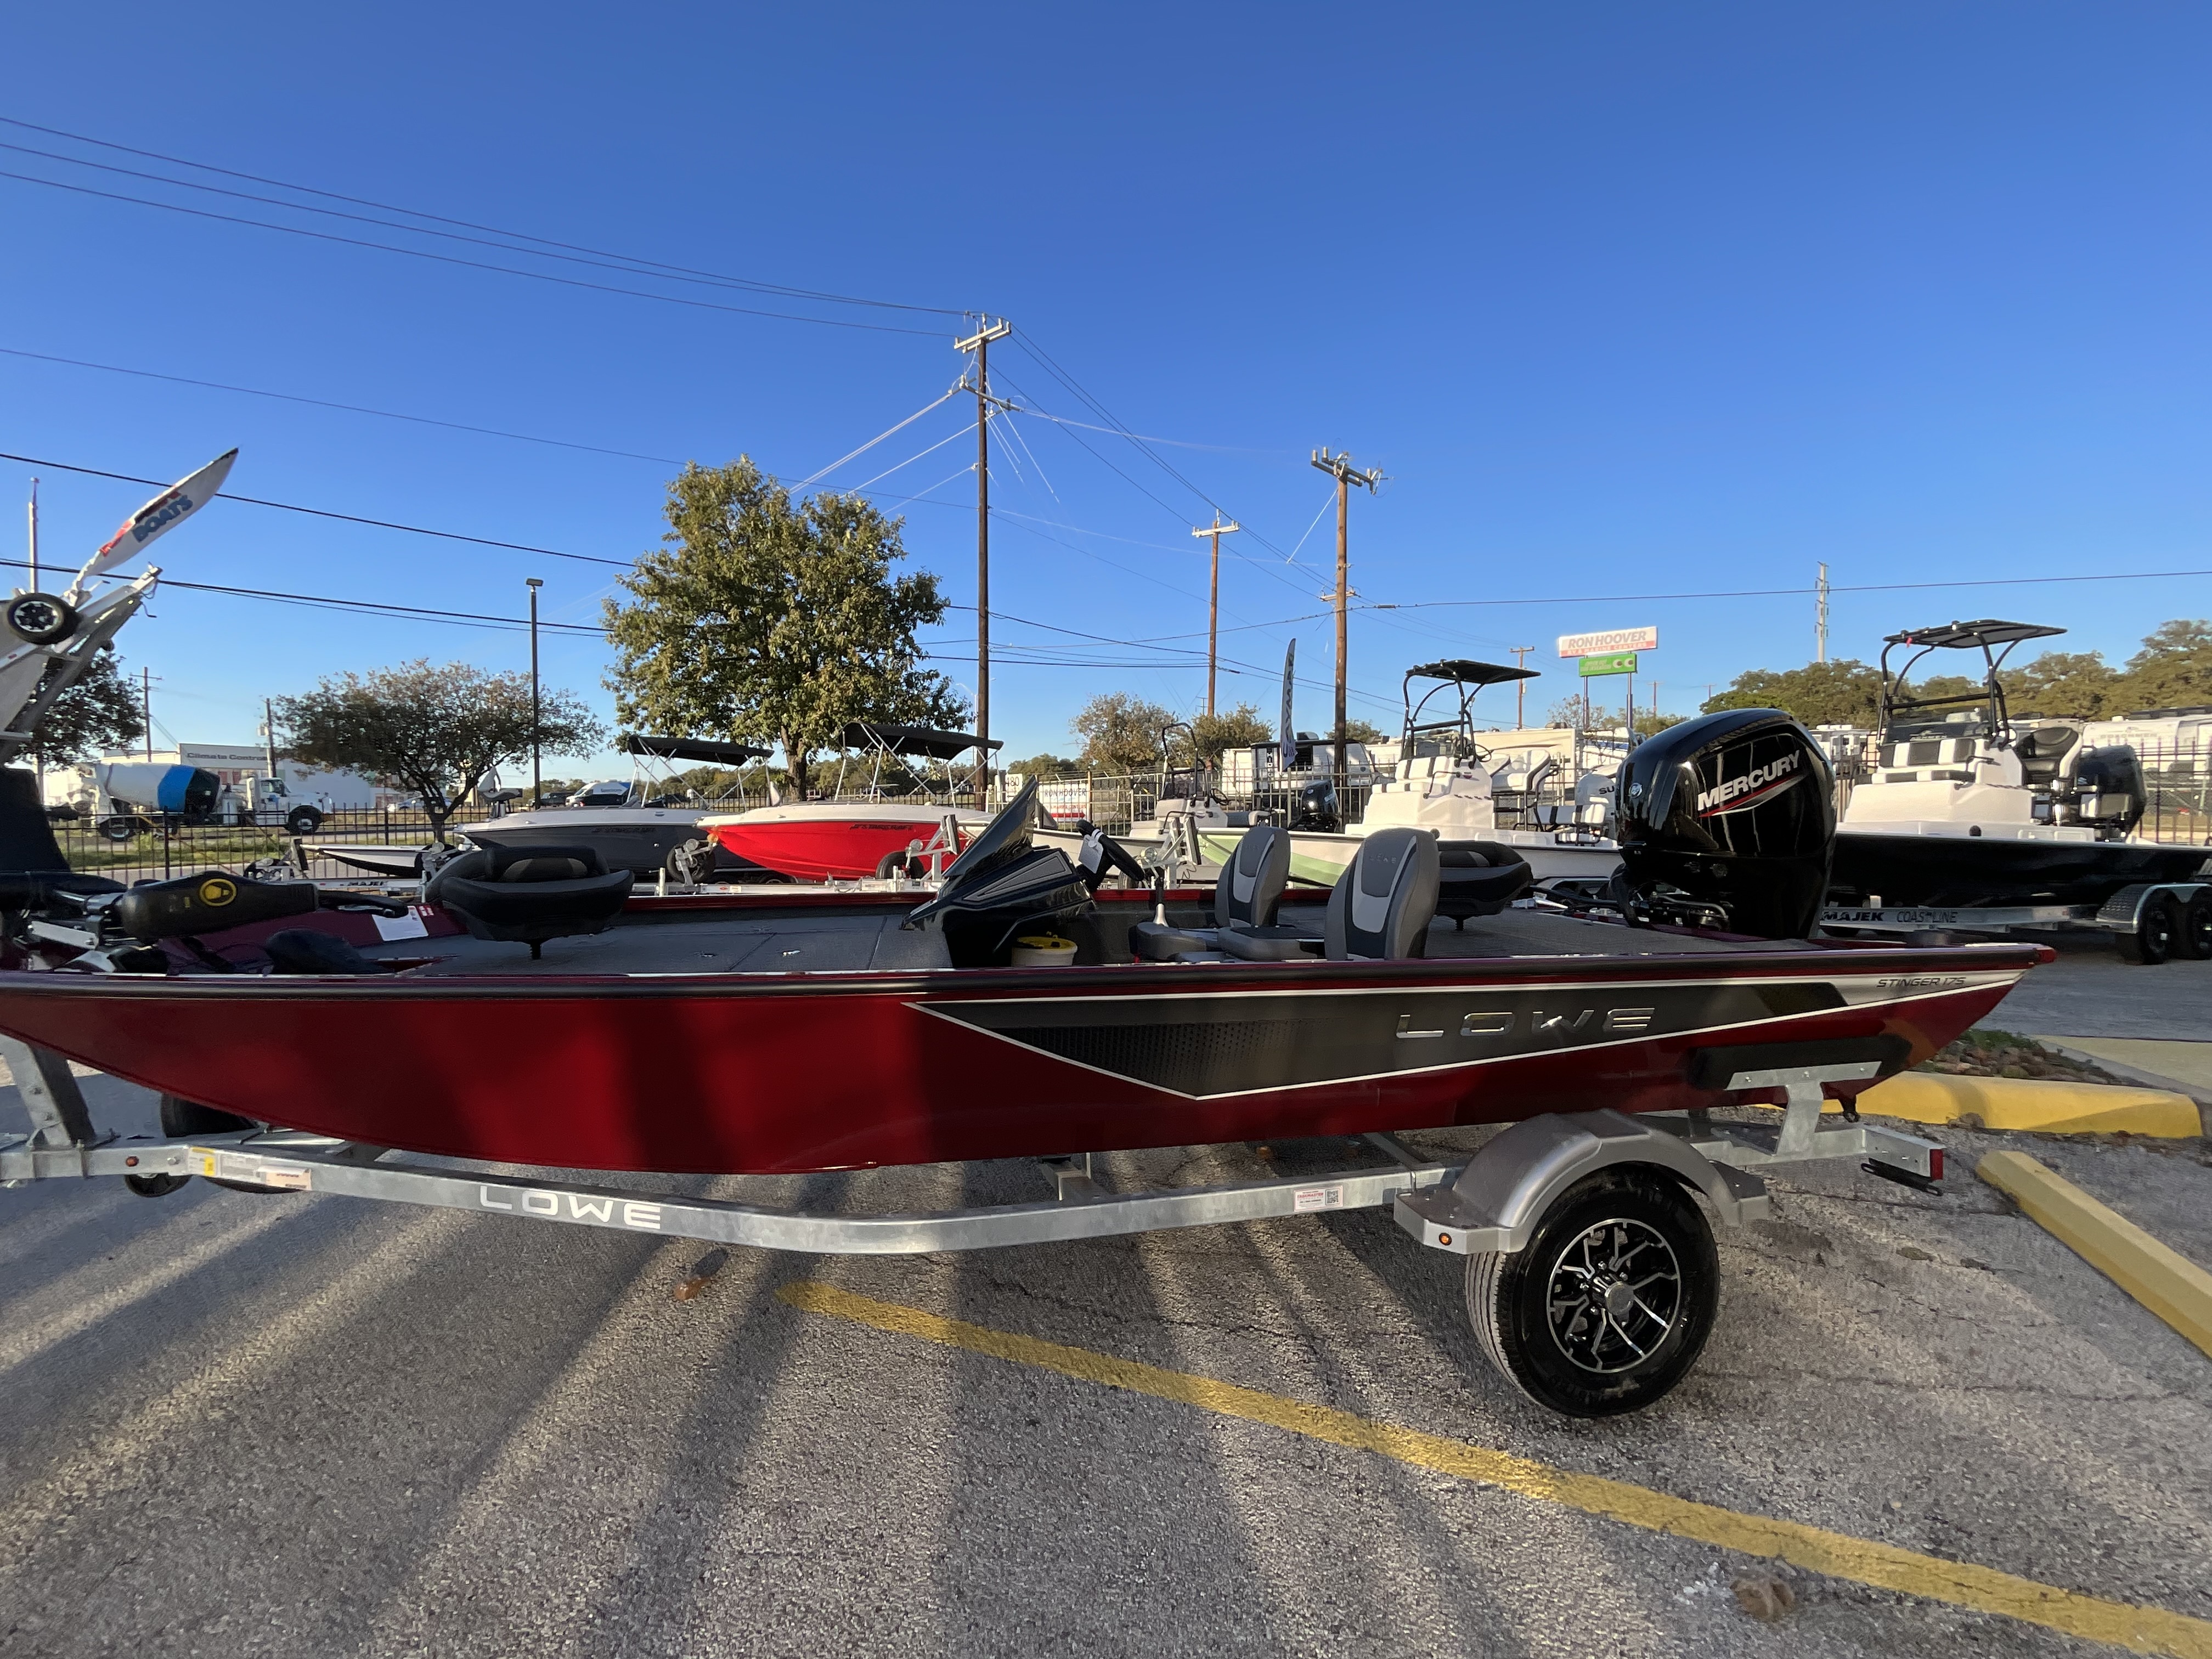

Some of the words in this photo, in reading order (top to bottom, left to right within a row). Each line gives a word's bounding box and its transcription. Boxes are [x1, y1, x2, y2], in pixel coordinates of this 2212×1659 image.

[131, 495, 194, 543] BOATS
[1568, 636, 1593, 649] RON
[1595, 630, 1647, 648] HOOVER
[1584, 646, 1612, 654] MARINE
[1613, 642, 1647, 650] CENTERS
[1697, 749, 1800, 811] MERCURY
[1045, 789, 1058, 798] RON
[1059, 787, 1087, 797] HOOVER
[1820, 911, 1886, 922] MAJEK
[1877, 978, 1940, 988] STINGER
[1396, 1007, 1655, 1039] LOWE
[479, 1185, 661, 1229] LOWE
